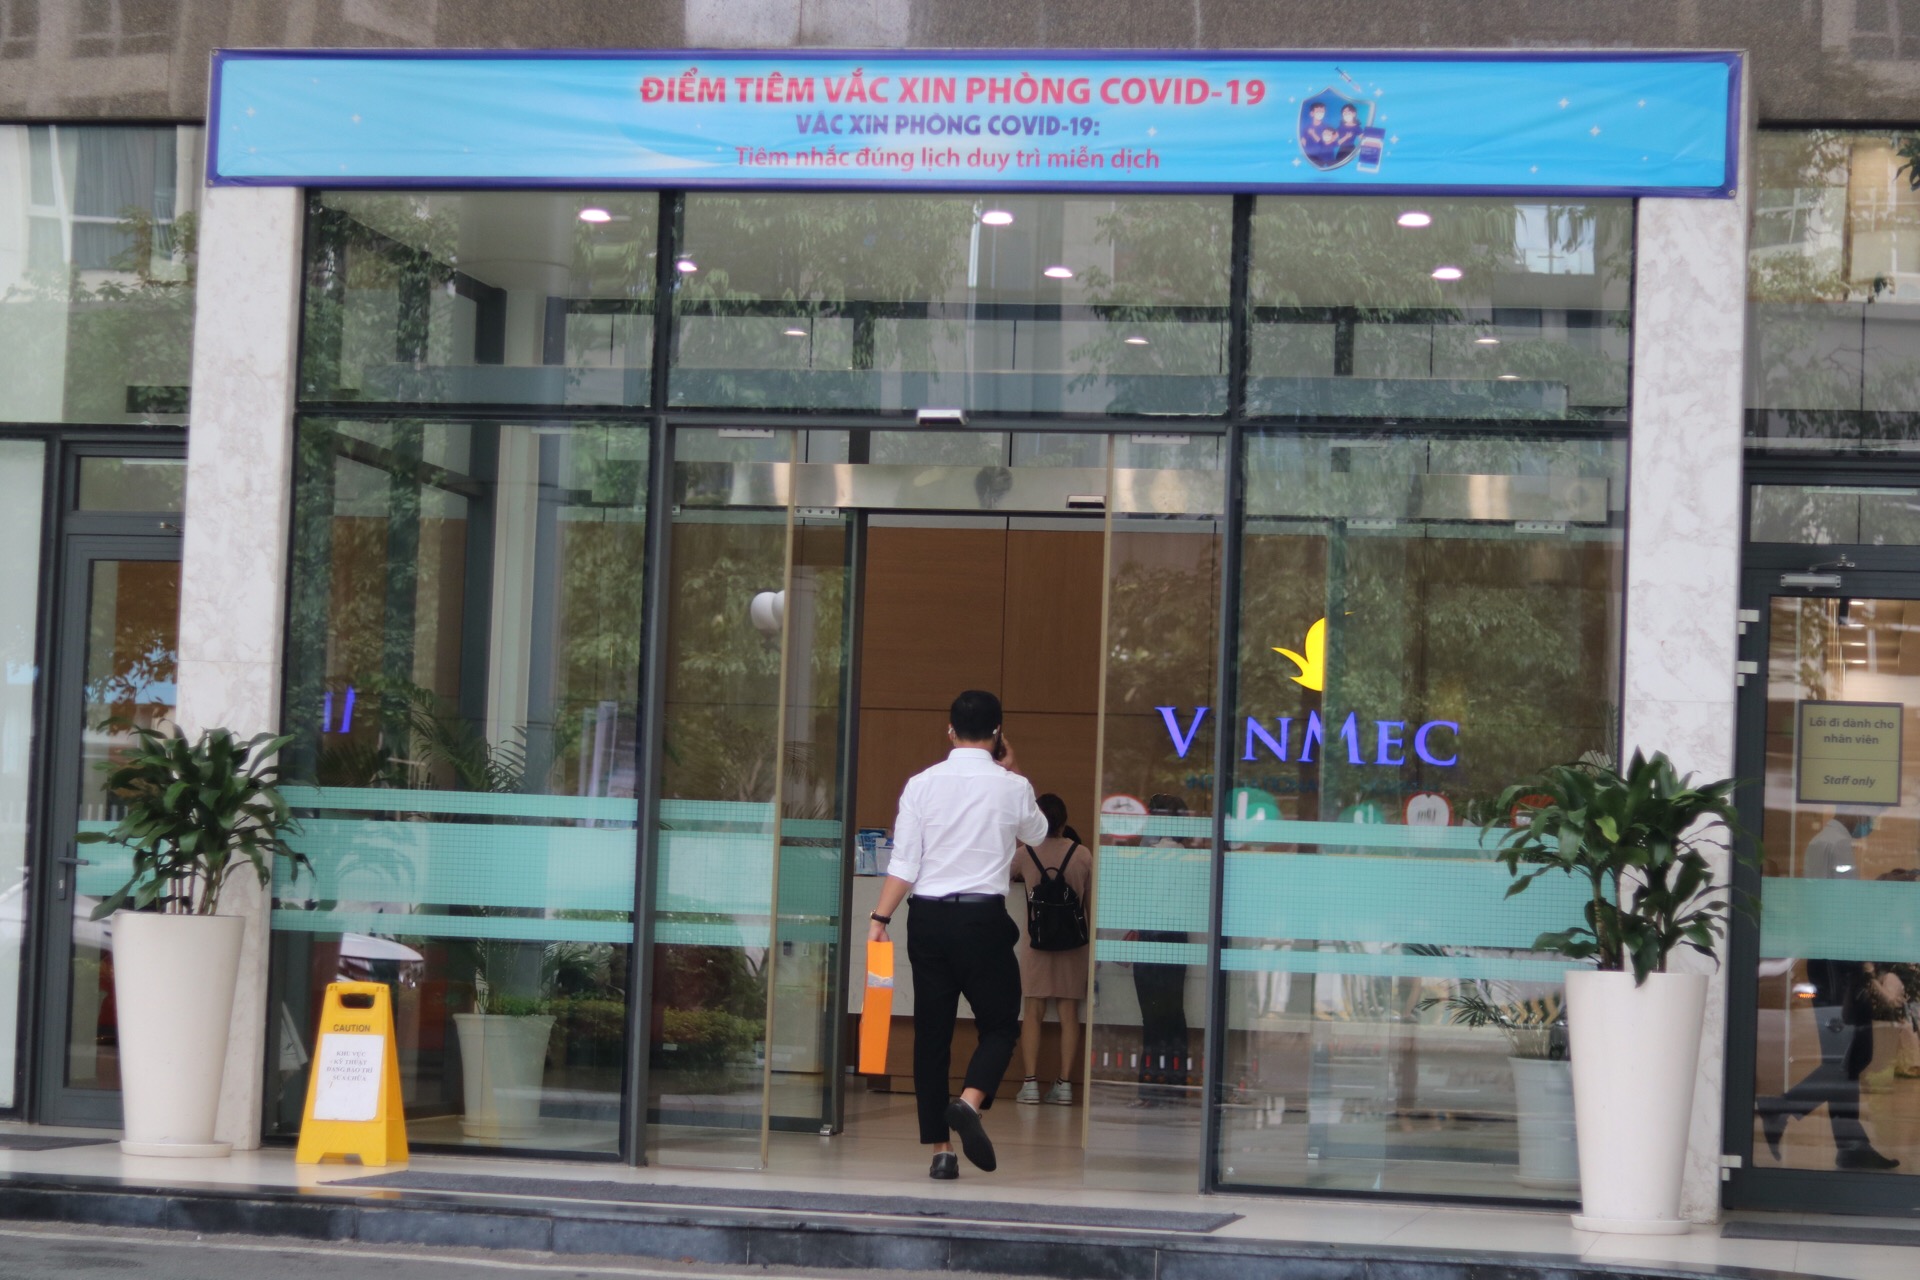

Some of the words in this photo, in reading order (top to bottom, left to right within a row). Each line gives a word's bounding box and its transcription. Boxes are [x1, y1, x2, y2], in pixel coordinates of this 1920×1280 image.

[640, 67, 726, 104] ĐIỂM
[734, 72, 815, 104] TIÊM
[823, 67, 890, 104] VẮC
[897, 77, 957, 104] XIN
[965, 72, 1091, 105] PHÒNG
[1100, 77, 1266, 106] COVID-19
[849, 114, 889, 135] XIN
[987, 115, 1100, 137] COVID-19:
[735, 146, 789, 167] Tiêm
[796, 144, 849, 167] nhắc
[856, 146, 914, 172] đúng
[922, 146, 960, 172] lịch
[966, 147, 1010, 173] duy
[1016, 147, 1040, 169] trì
[1047, 145, 1103, 169] miễn
[1111, 148, 1160, 174] dịch
[1842, 718, 1871, 729] dành
[1874, 719, 1895, 729] cho
[1823, 775, 1851, 785] Staff
[1851, 776, 1876, 788] only
[333, 1024, 371, 1032] CAUTION
